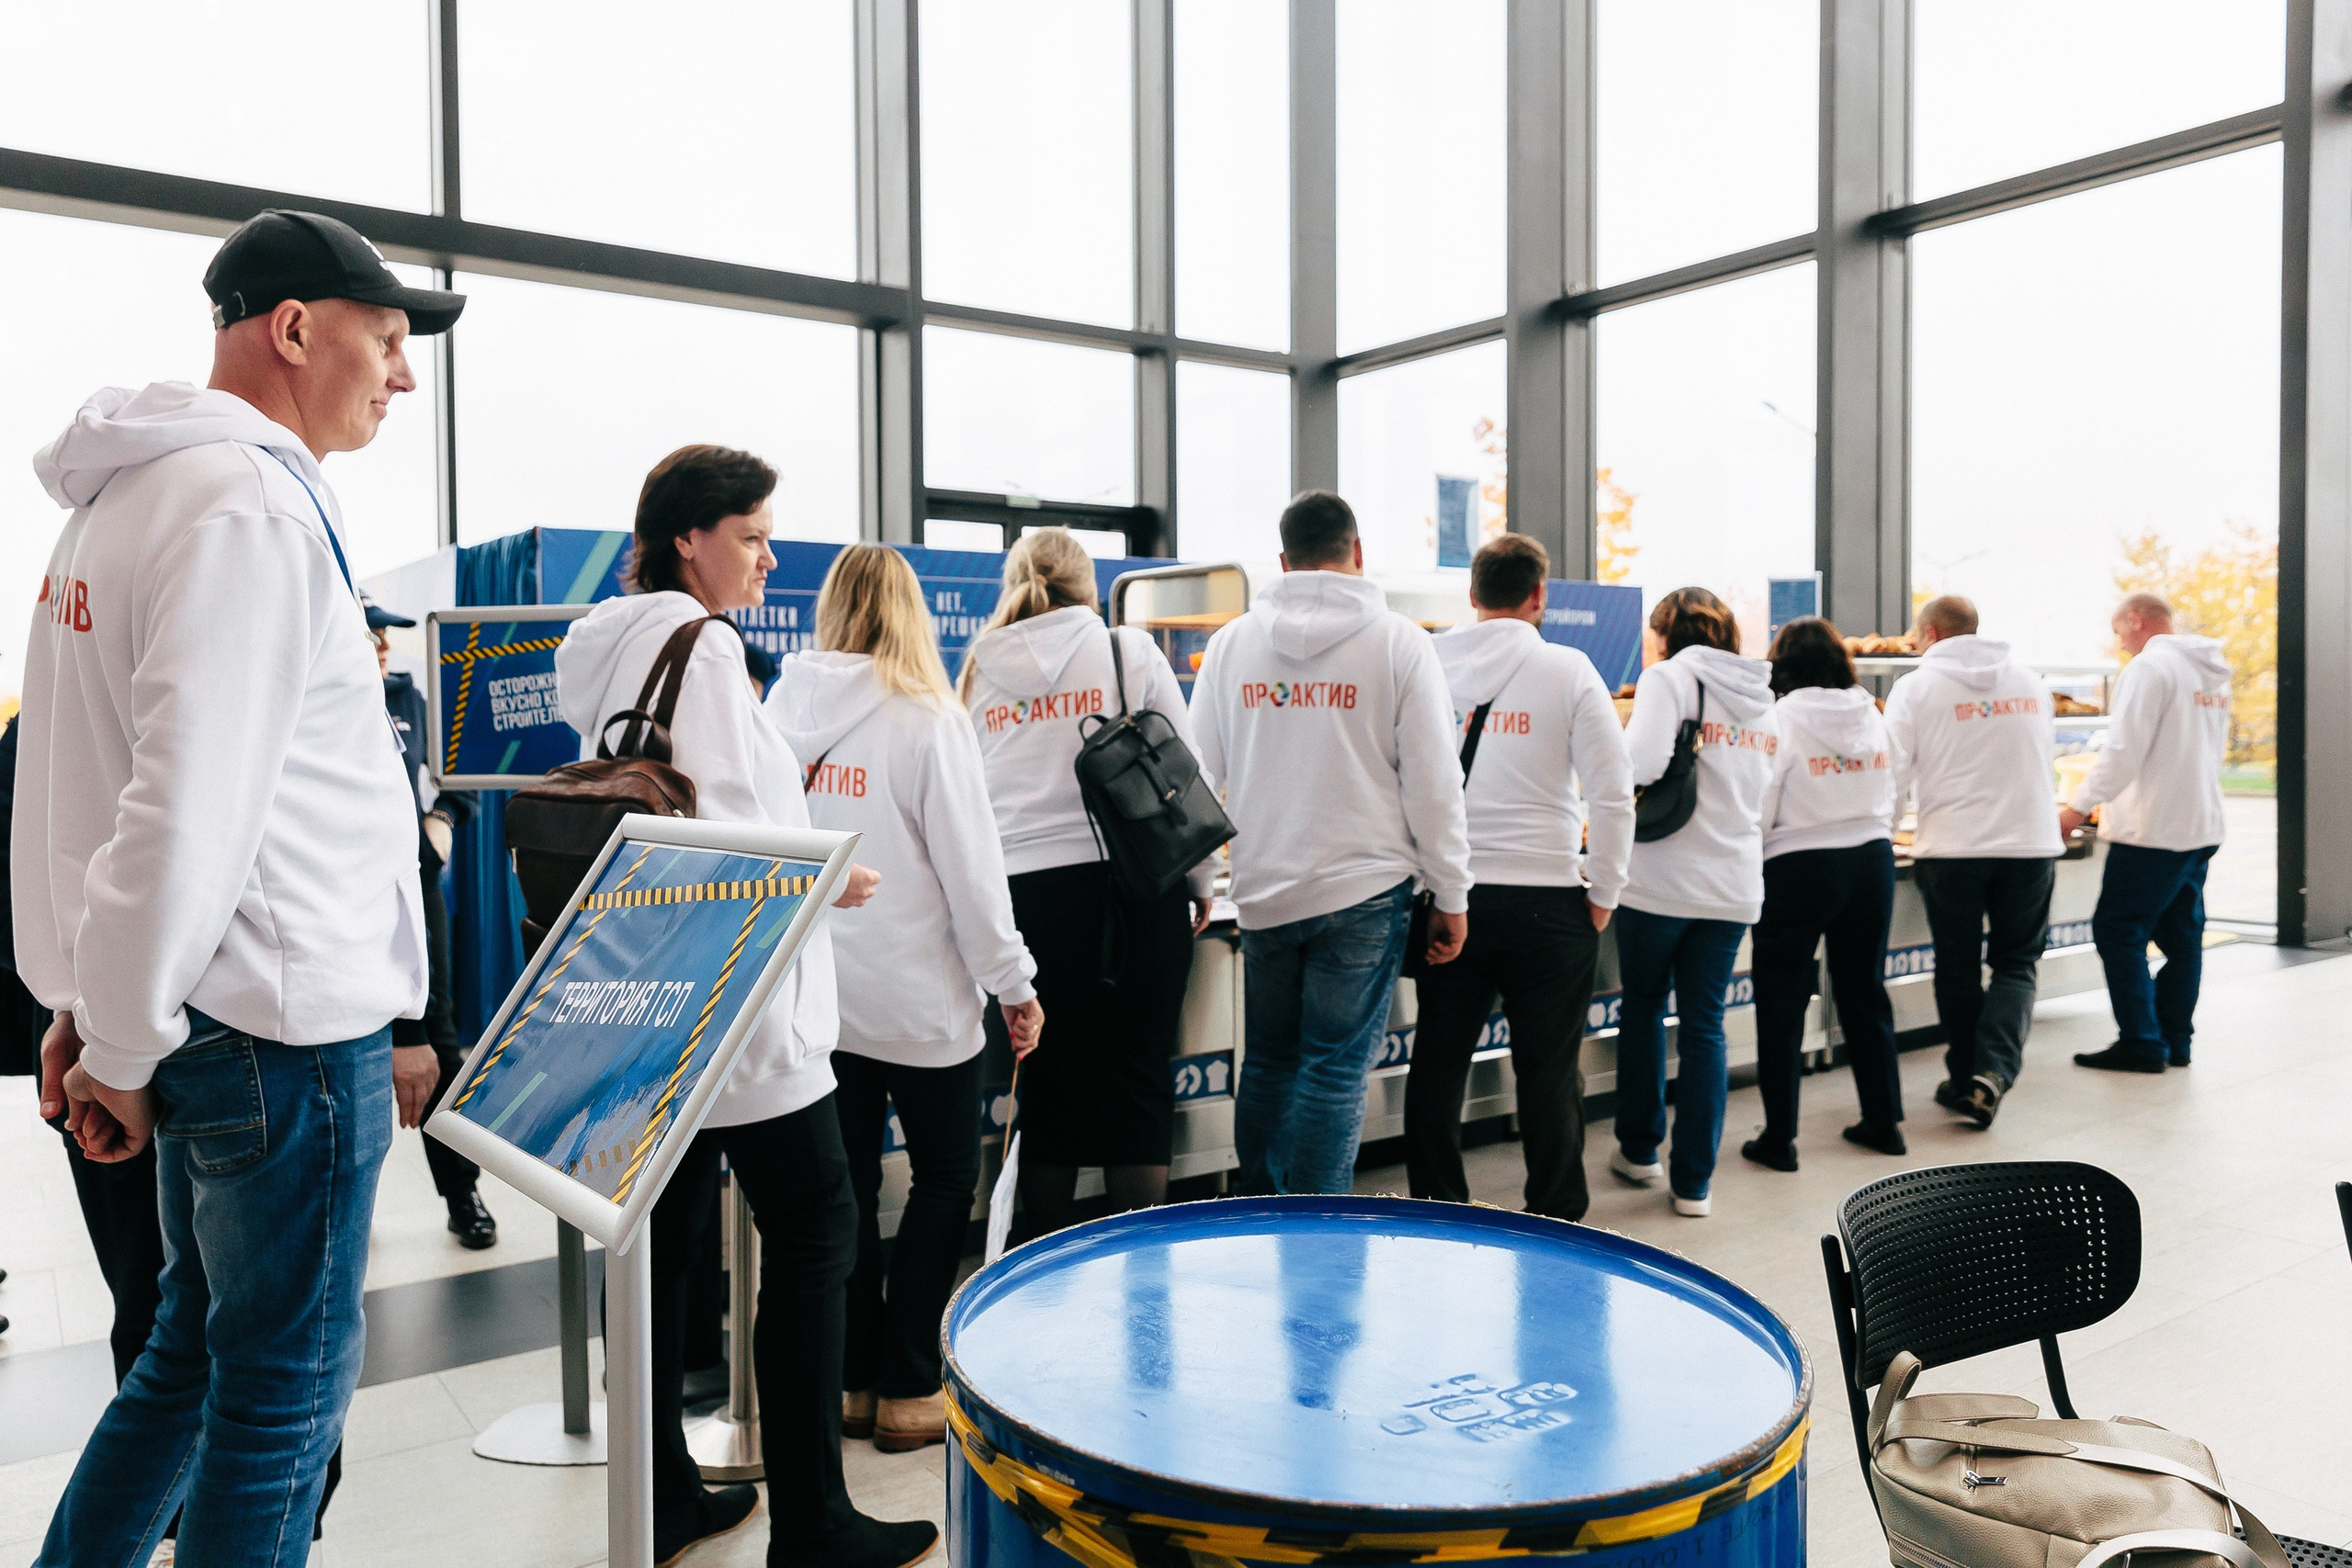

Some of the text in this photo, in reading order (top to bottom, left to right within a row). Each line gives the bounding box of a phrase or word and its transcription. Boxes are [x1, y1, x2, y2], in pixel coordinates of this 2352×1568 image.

[728, 605, 798, 628] ТЛЕТКИ
[488, 671, 557, 698] ОСТОРОЖН
[491, 691, 542, 715] ВКУСНО
[493, 705, 564, 732] СТРОИТЕЛ
[548, 980, 696, 1028] ТЕРРИТОРИЯ ГСП
